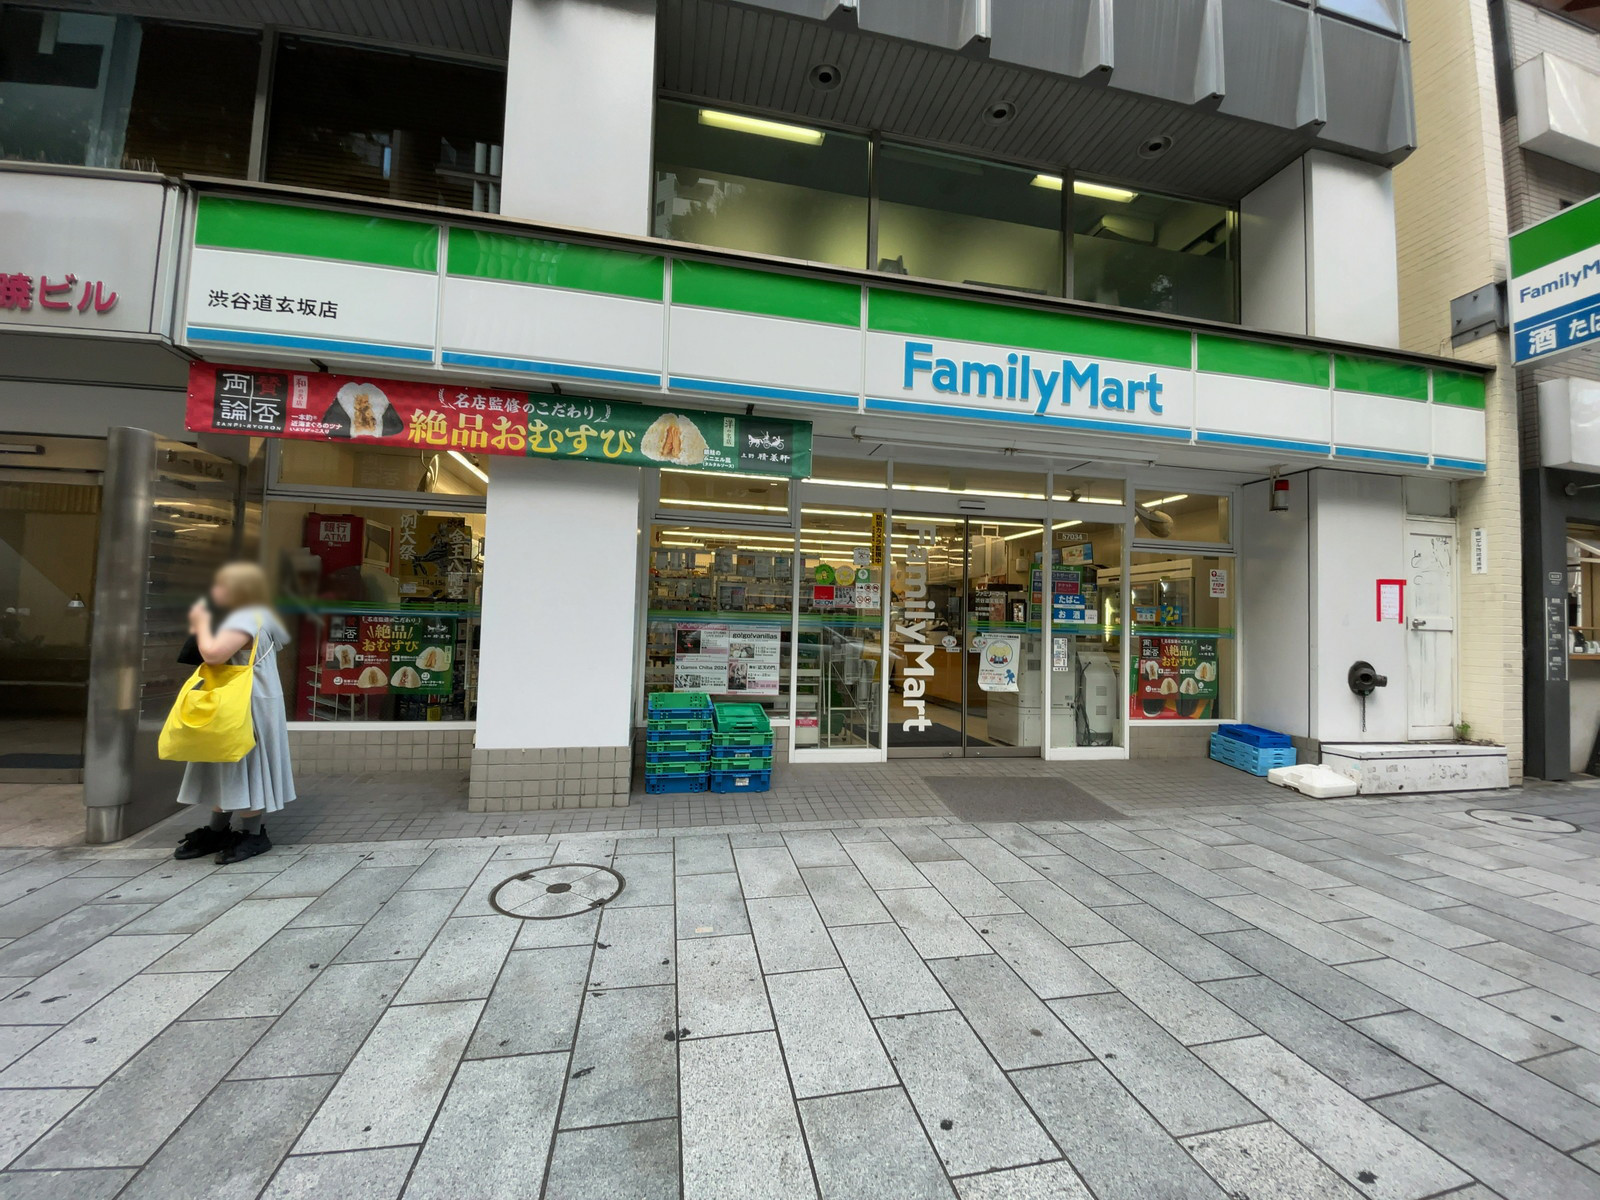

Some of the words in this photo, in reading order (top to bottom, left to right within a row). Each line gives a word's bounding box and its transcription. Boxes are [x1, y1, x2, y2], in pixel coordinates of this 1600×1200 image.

[208, 289, 338, 319] 渋谷道玄坂店
[1528, 323, 1557, 355] 酒
[904, 341, 1164, 416] FamilyMart
[454, 392, 594, 420] 名店監修のこだわり
[408, 408, 636, 458] 絶品おむすび
[324, 522, 348, 533] 銀行
[323, 533, 347, 542] ATM
[1061, 532, 1083, 541] 57034
[1058, 595, 1080, 604] たばこ
[375, 624, 408, 639] 絶品
[895, 523, 937, 732] FamilyMart
[732, 632, 778, 640] go!go!vanillas
[362, 639, 420, 653] おむすび
